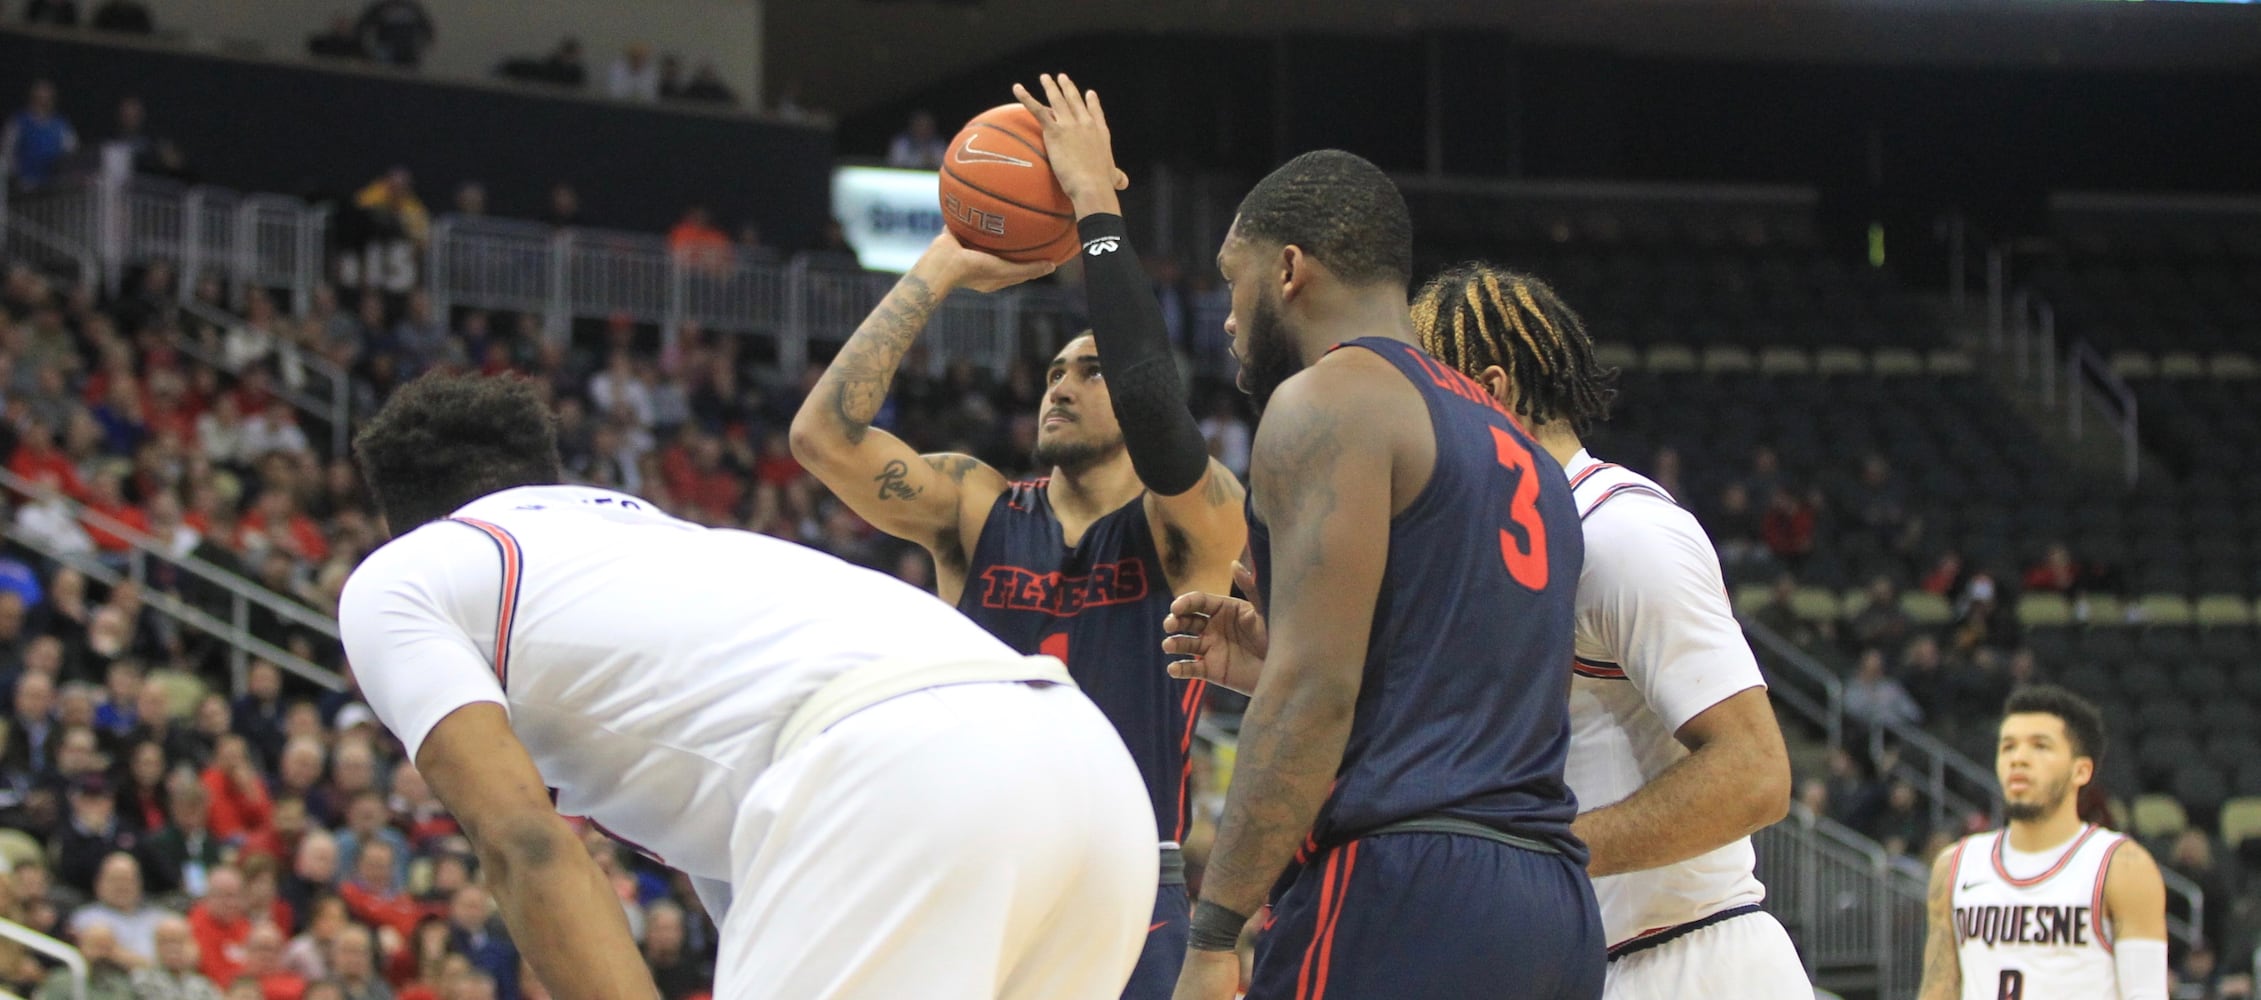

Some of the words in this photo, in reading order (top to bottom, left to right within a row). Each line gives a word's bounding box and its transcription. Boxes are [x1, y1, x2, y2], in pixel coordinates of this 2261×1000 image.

[944, 191, 1006, 236] ELITE
[1488, 424, 1549, 591] 3
[980, 557, 1149, 618] FLYERS
[1953, 905, 2092, 949] DUQUESNE
